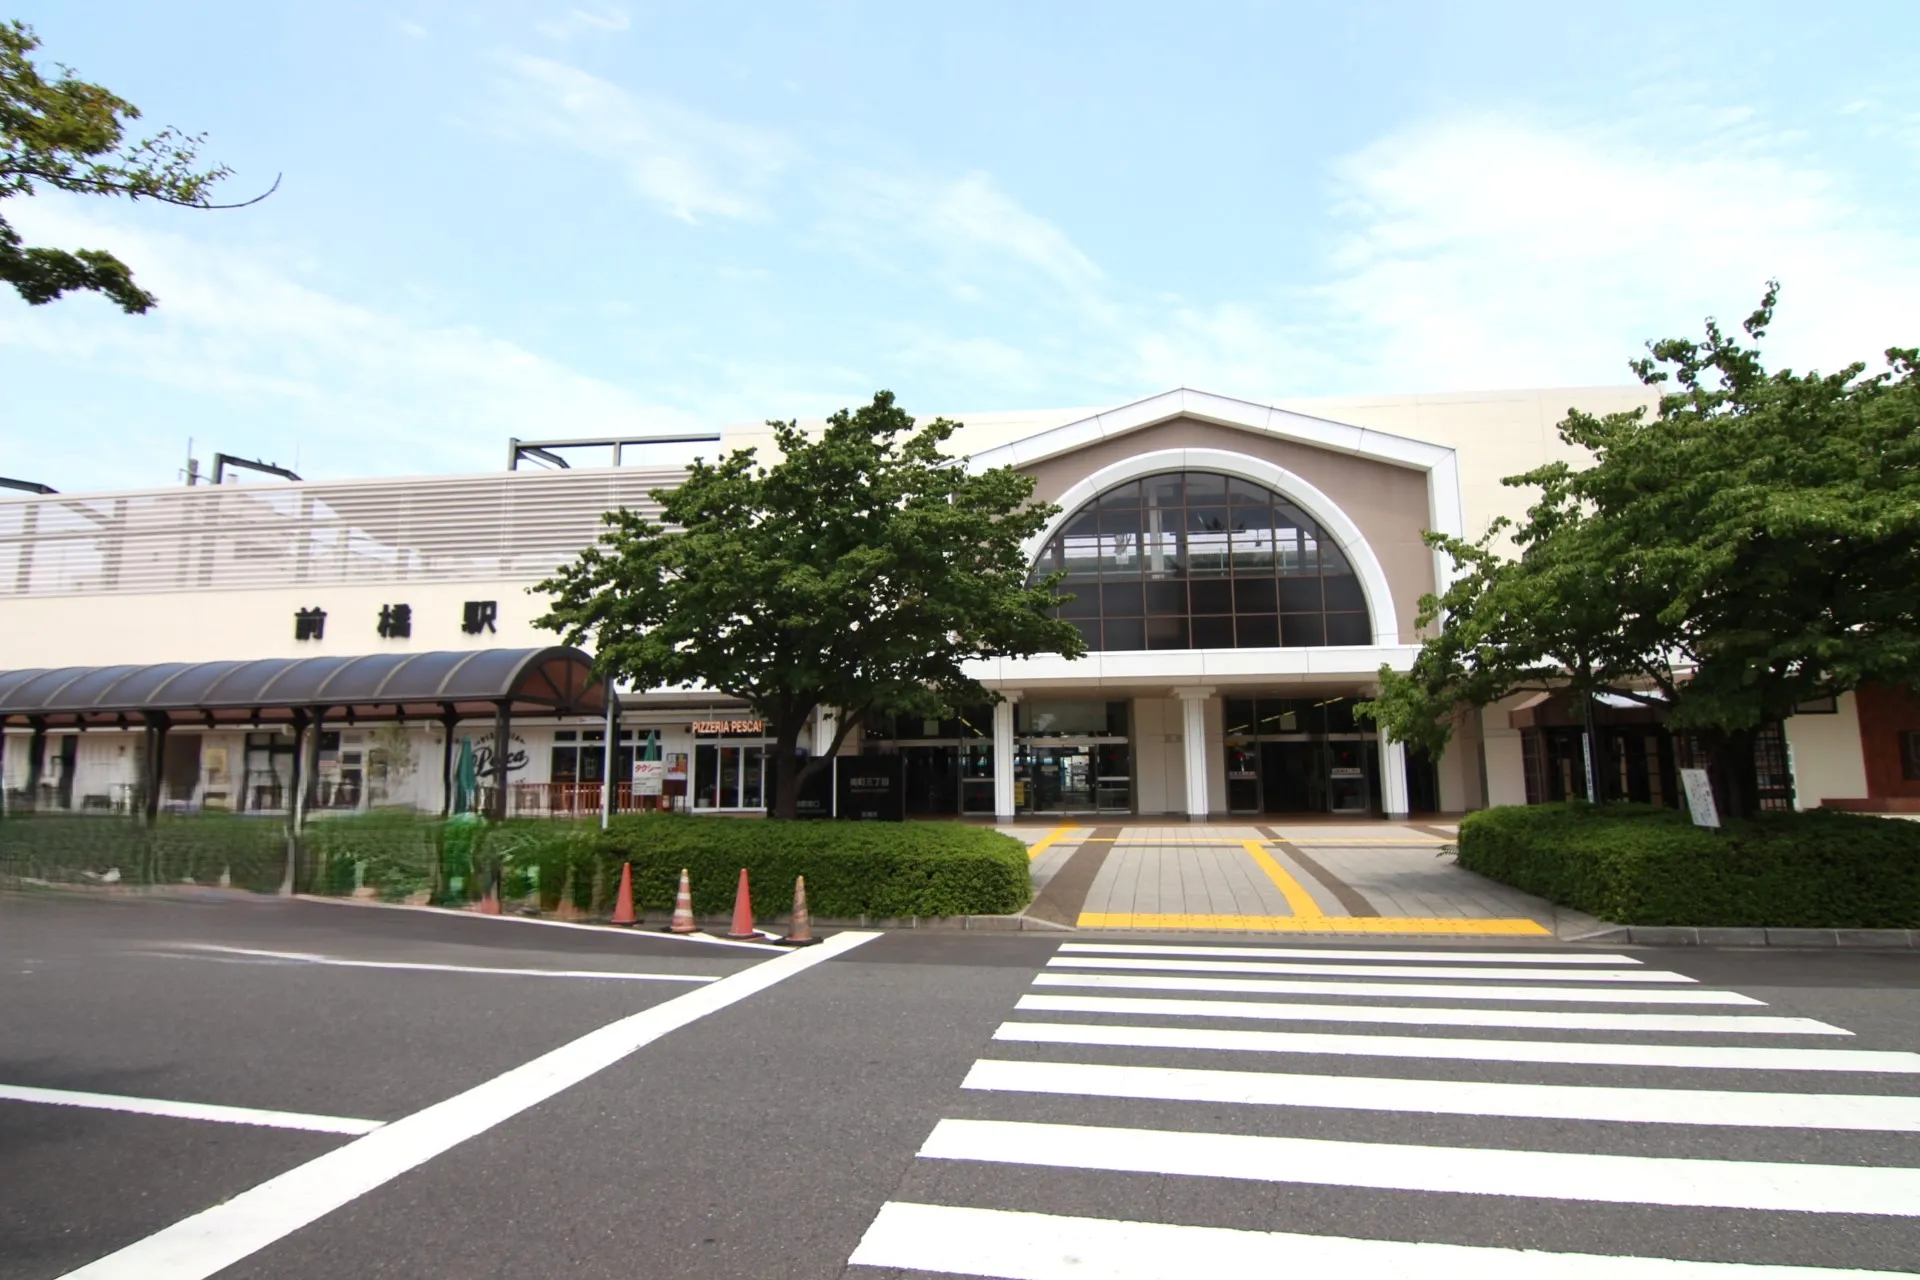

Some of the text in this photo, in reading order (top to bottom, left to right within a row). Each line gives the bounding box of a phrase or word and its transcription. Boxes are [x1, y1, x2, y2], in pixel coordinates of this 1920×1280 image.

[294, 601, 497, 640] 前橋駅
[692, 720, 763, 734] PIZZERIA PESCA!
